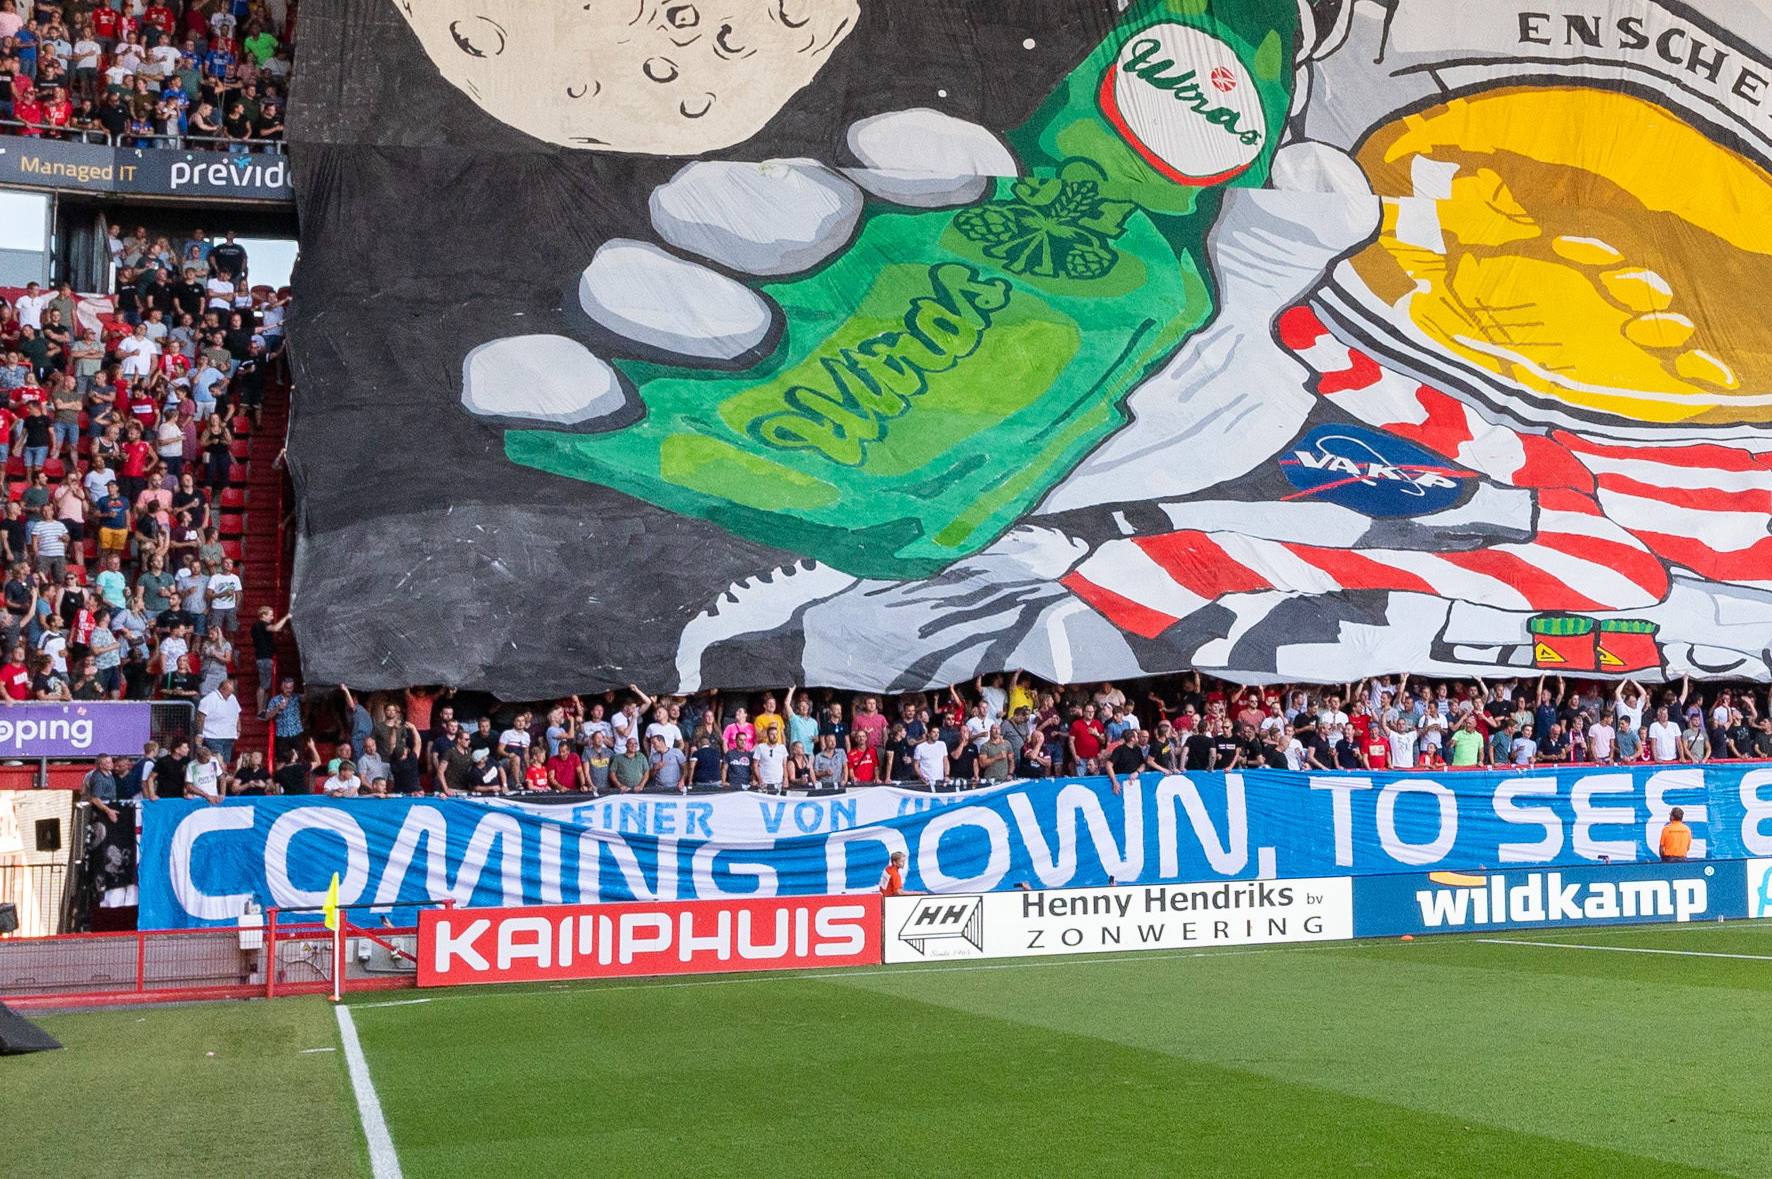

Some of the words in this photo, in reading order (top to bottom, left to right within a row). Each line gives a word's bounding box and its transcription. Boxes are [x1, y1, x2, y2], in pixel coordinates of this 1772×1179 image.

[21, 156, 113, 182] Managed
[119, 165, 137, 181] IT
[170, 157, 294, 189] previd
[1294, 450, 1457, 489] VAKP
[572, 801, 714, 839] EINER
[759, 798, 858, 834] VON
[169, 805, 779, 920] COMING
[825, 773, 1277, 896] DOWN,
[1309, 776, 1458, 867] TO
[1492, 768, 1708, 864] SEE
[914, 904, 969, 926] HH
[1023, 892, 1133, 919] Henny
[1145, 883, 1294, 914] Hendriks
[1307, 891, 1324, 906] bv
[1416, 872, 1708, 927] wildkamp
[435, 905, 866, 973] KAMPHUIS
[1028, 916, 1324, 949] ZONWERING
